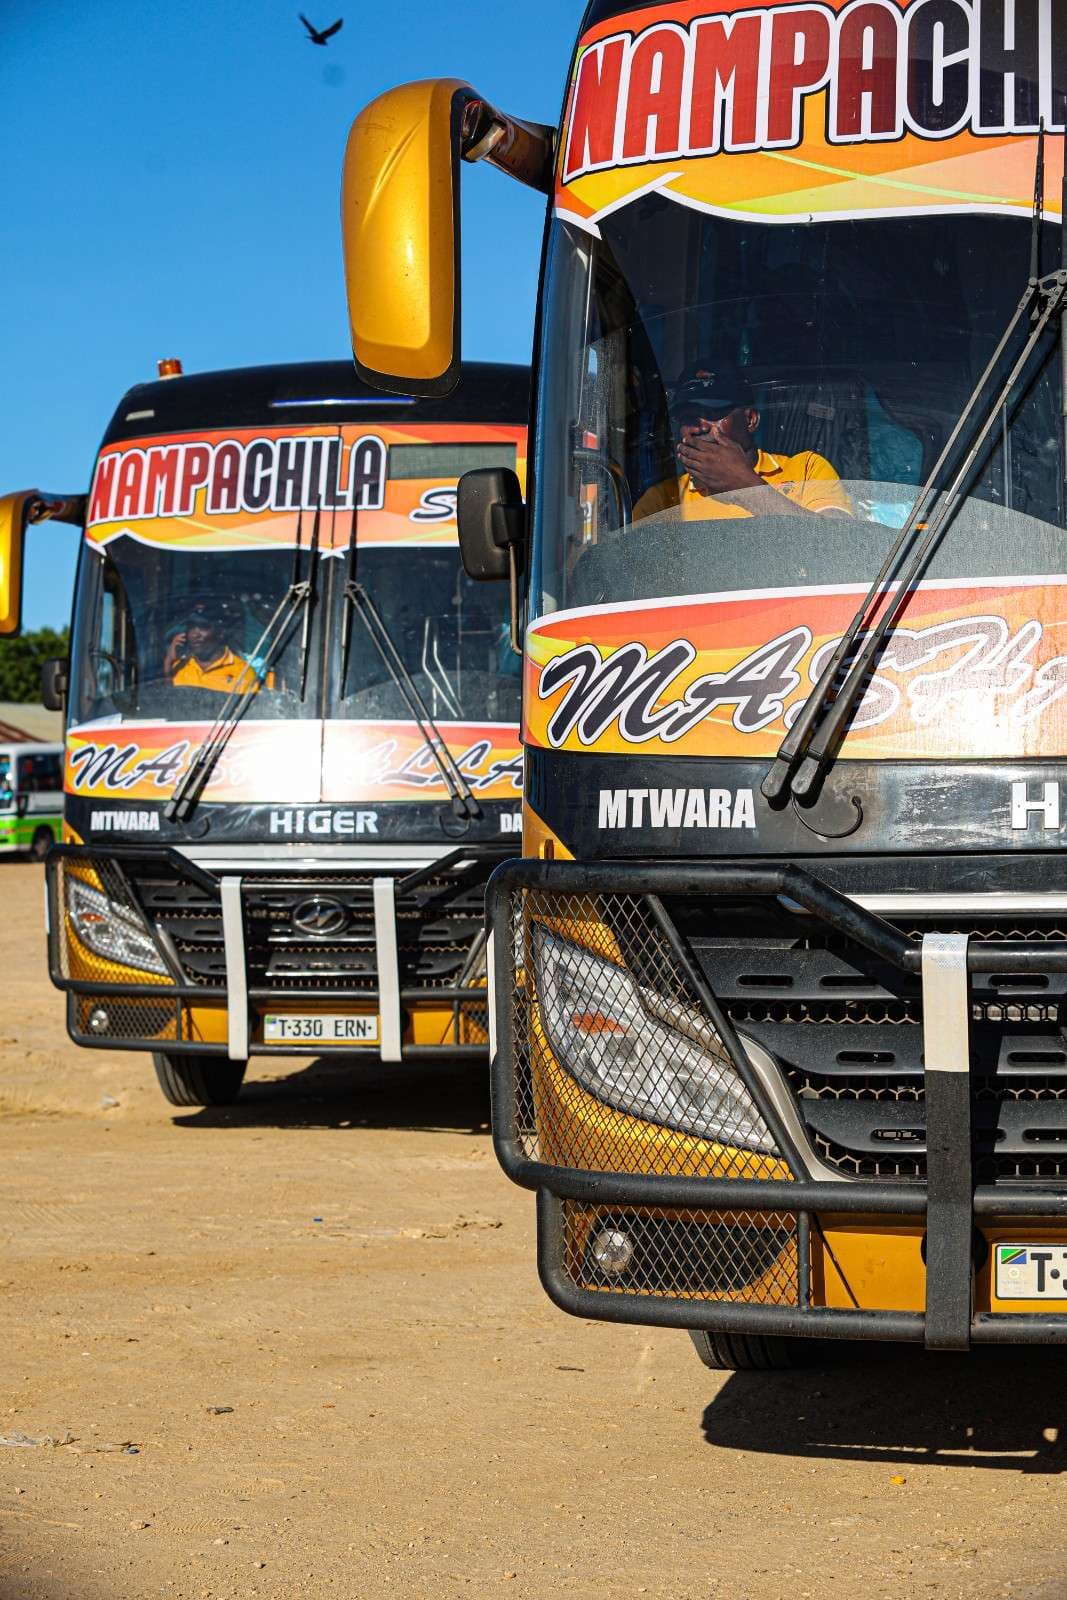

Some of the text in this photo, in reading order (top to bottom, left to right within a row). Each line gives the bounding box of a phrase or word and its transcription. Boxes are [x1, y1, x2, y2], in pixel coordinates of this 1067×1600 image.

[89, 436, 386, 524] NAMPACHILA
[90, 811, 160, 831] MTWARA
[269, 810, 378, 834] HIGER
[598, 788, 756, 829] MTWARA
[1011, 782, 1059, 830] H
